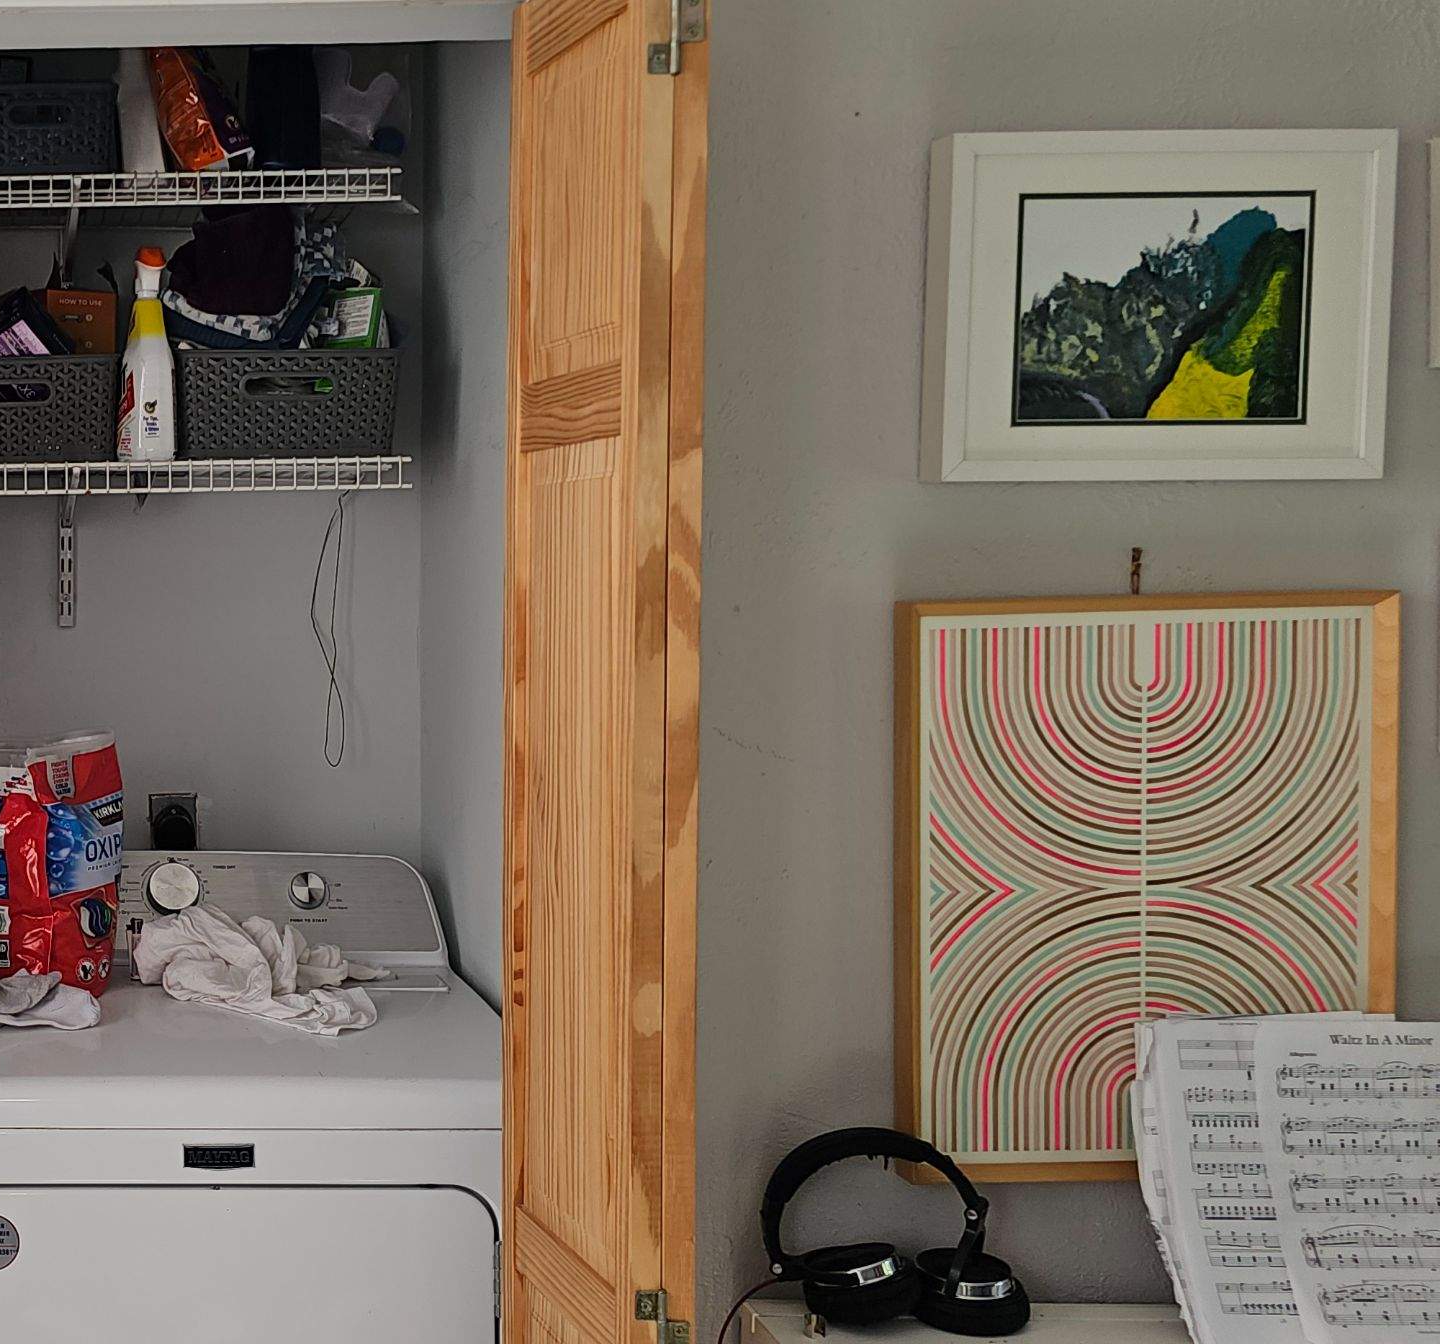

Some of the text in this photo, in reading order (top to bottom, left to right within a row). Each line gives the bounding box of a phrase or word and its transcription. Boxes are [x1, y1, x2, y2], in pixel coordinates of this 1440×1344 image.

[1328, 1033, 1434, 1047] Waltz In A Minor
[187, 1150, 250, 1163] MAYTAG
